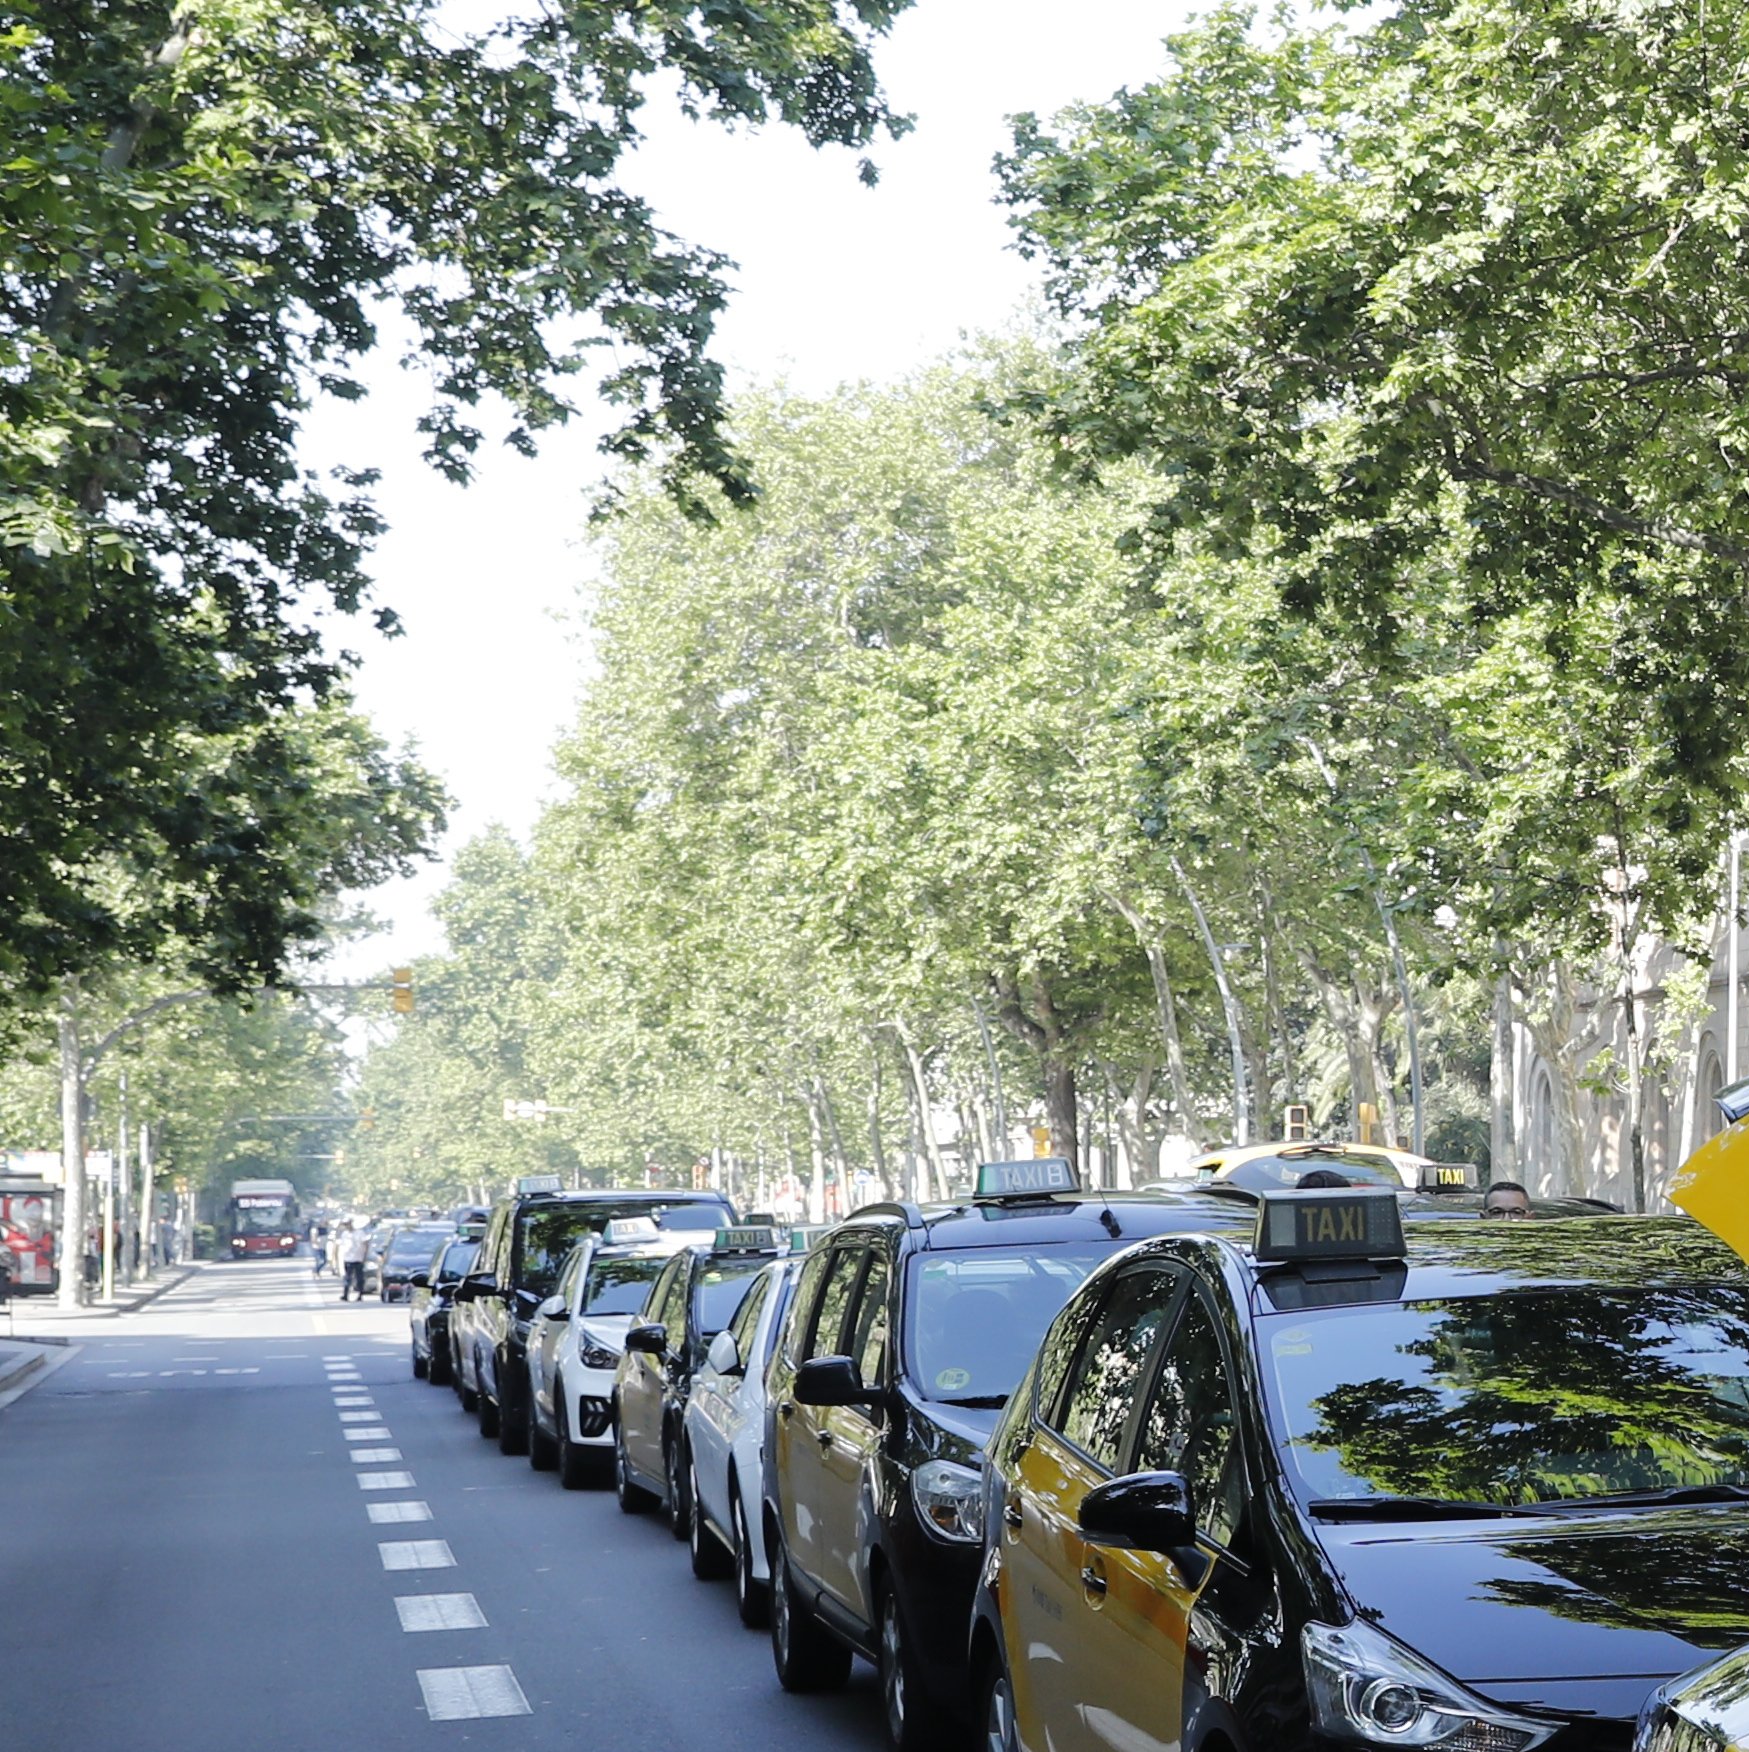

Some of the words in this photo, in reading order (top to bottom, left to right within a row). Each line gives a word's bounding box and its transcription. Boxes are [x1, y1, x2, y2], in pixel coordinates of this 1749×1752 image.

[1001, 1165, 1043, 1189] TAXI
[1437, 1168, 1465, 1185] TAXI
[1301, 1205, 1364, 1243] TAXI
[727, 1231, 754, 1246] TAXI
